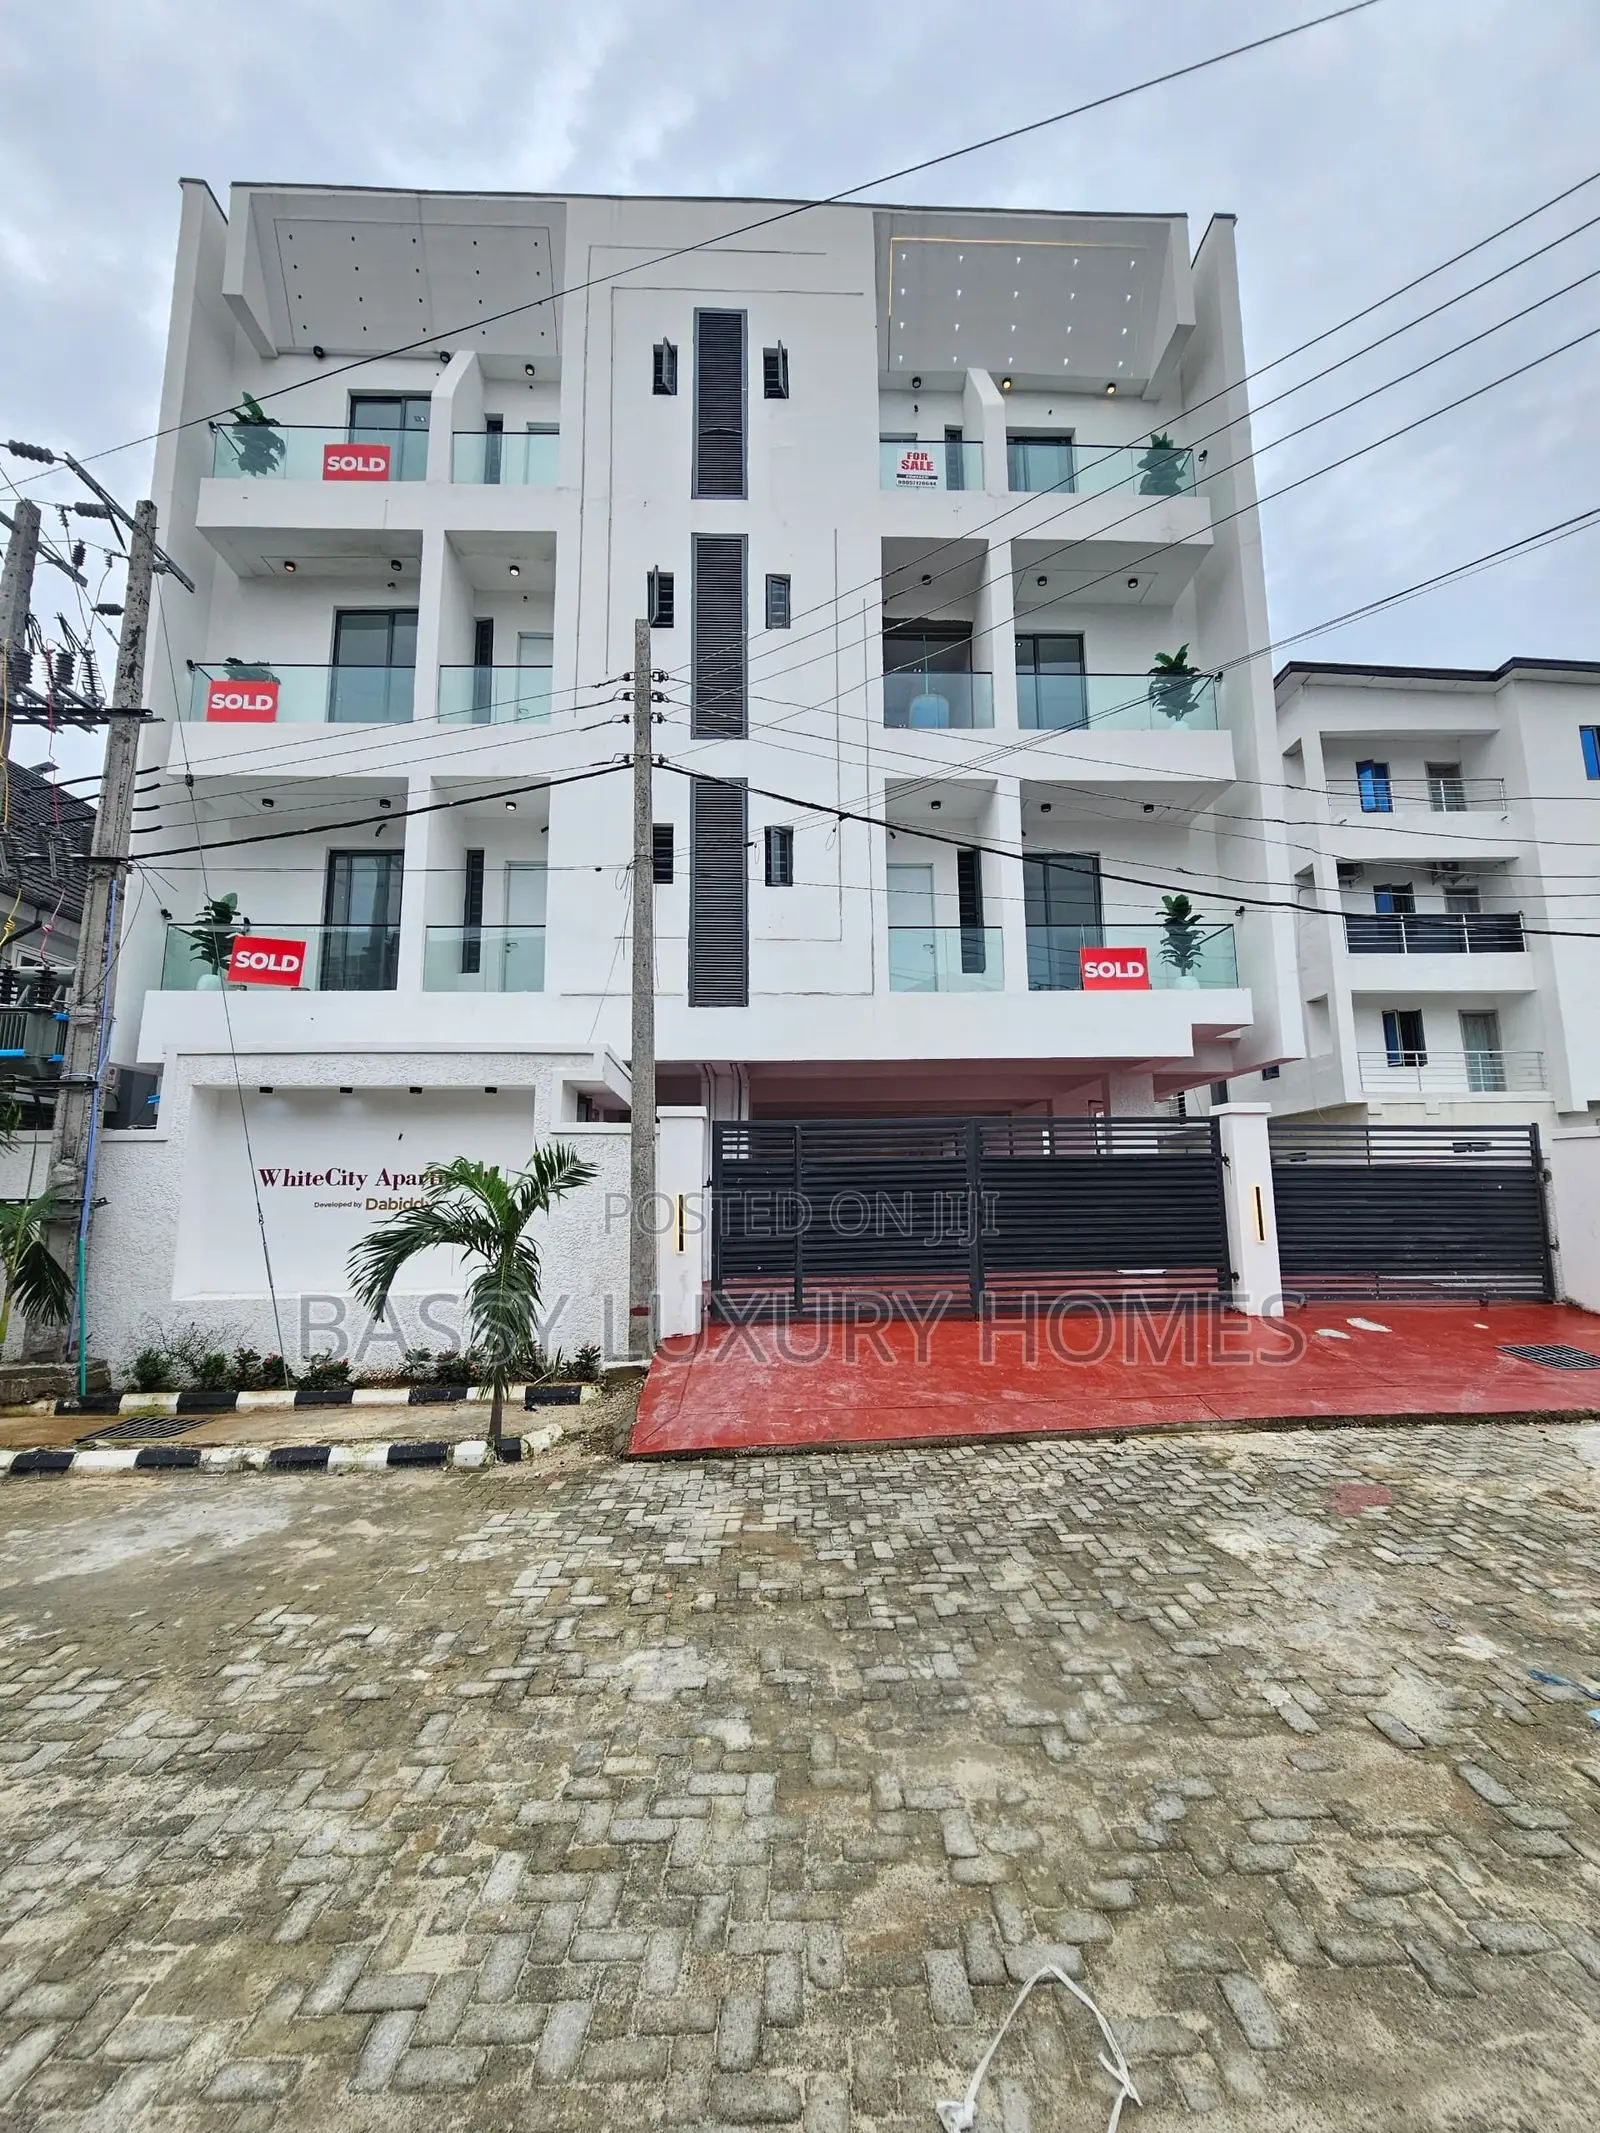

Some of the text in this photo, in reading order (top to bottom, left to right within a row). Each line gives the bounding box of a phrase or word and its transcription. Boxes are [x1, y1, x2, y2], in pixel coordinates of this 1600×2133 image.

[906, 451, 928, 460] FOR
[327, 456, 386, 472] SOLD
[901, 459, 934, 472] SALE
[210, 693, 273, 711] SOLD
[234, 950, 300, 972] SOLD
[1084, 961, 1144, 978] SOLD
[259, 1168, 488, 1191] WhiteCity Apart
[314, 1201, 352, 1209] Developed
[353, 1200, 362, 1209] by
